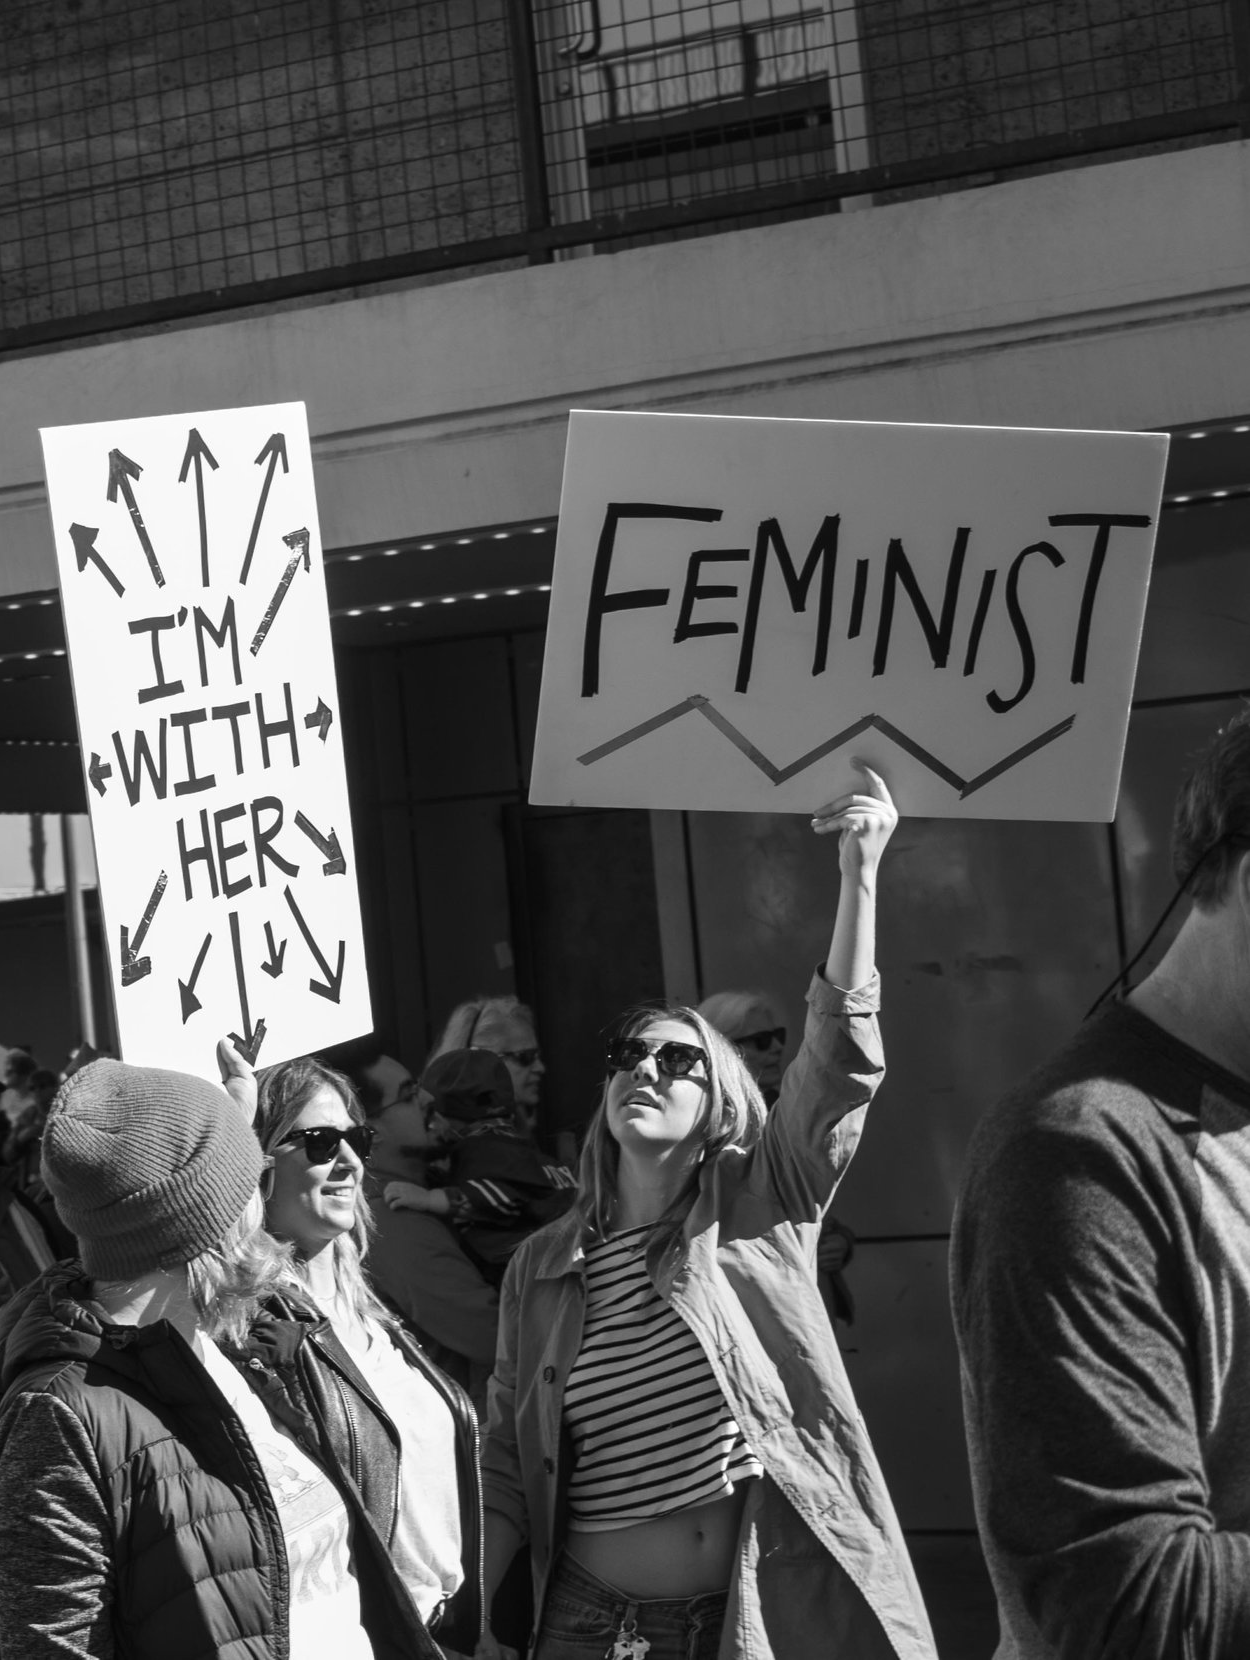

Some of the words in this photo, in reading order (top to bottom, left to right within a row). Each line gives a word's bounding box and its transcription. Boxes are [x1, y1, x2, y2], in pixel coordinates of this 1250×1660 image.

[127, 595, 243, 704] I'M
[580, 502, 1152, 714] FEMINIST
[111, 682, 300, 807] WITH
[176, 795, 300, 902] HER
